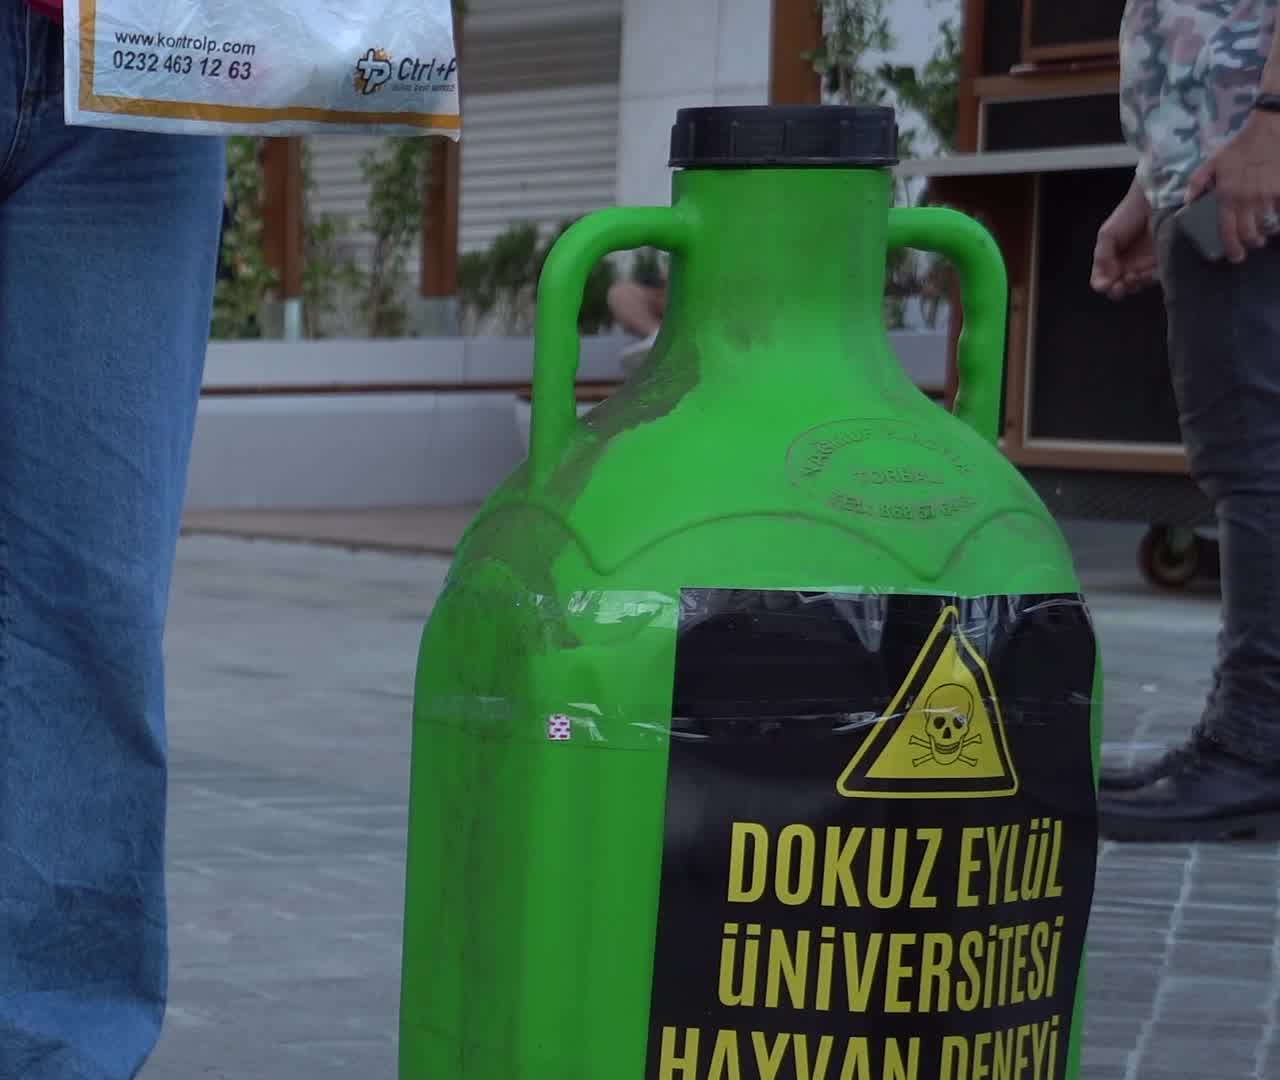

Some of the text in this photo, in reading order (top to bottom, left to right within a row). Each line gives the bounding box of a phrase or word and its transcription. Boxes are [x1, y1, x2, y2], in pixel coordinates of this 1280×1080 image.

[113, 50, 252, 80] 0232 463 12 63
[115, 32, 256, 55] www.kontrolp.com
[727, 818, 1063, 908] DOKUZ EYLÜL
[718, 915, 1064, 1013] ÜNİVERSİTESİ
